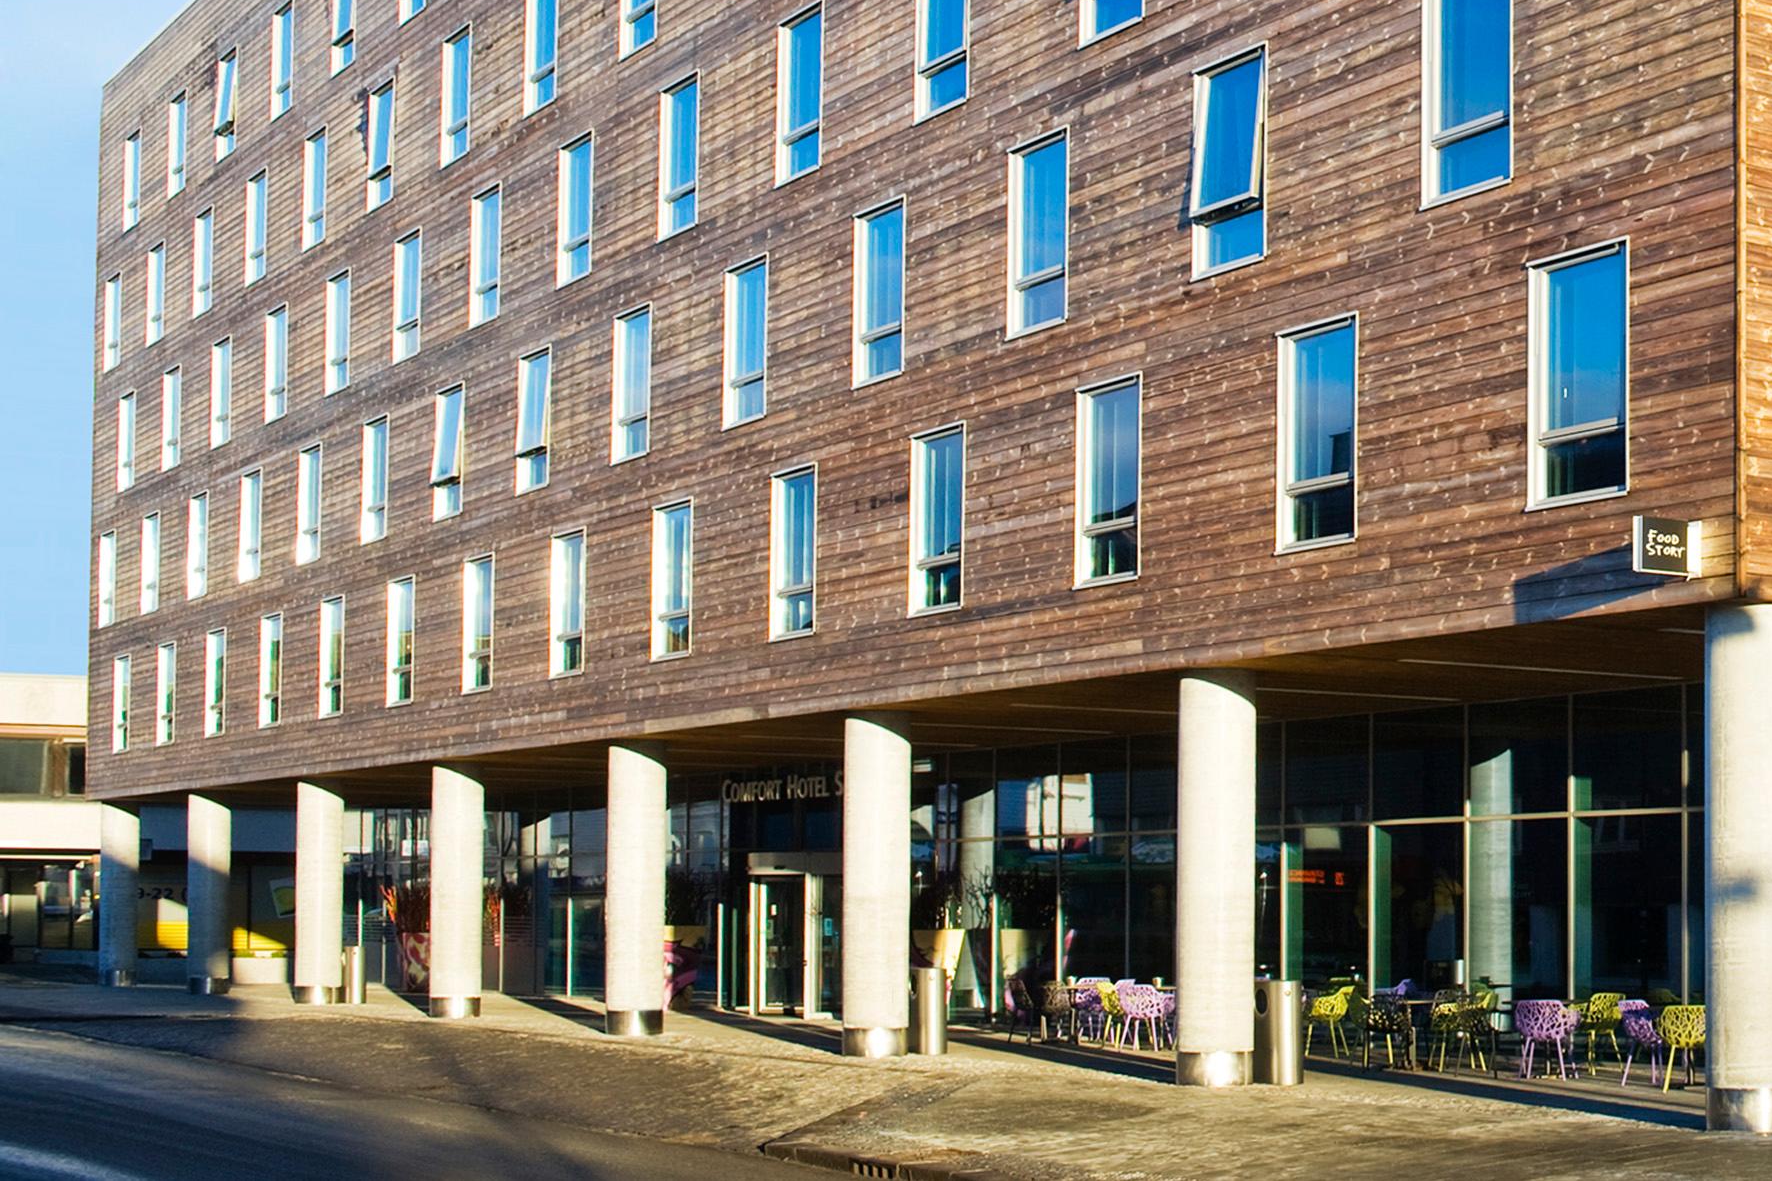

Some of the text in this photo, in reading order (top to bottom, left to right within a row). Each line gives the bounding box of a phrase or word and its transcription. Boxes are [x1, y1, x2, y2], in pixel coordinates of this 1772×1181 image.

[1647, 528, 1680, 545] FOOD
[1645, 542, 1686, 558] STORY
[721, 778, 783, 803] COMFORT
[786, 774, 829, 799] HOTEL
